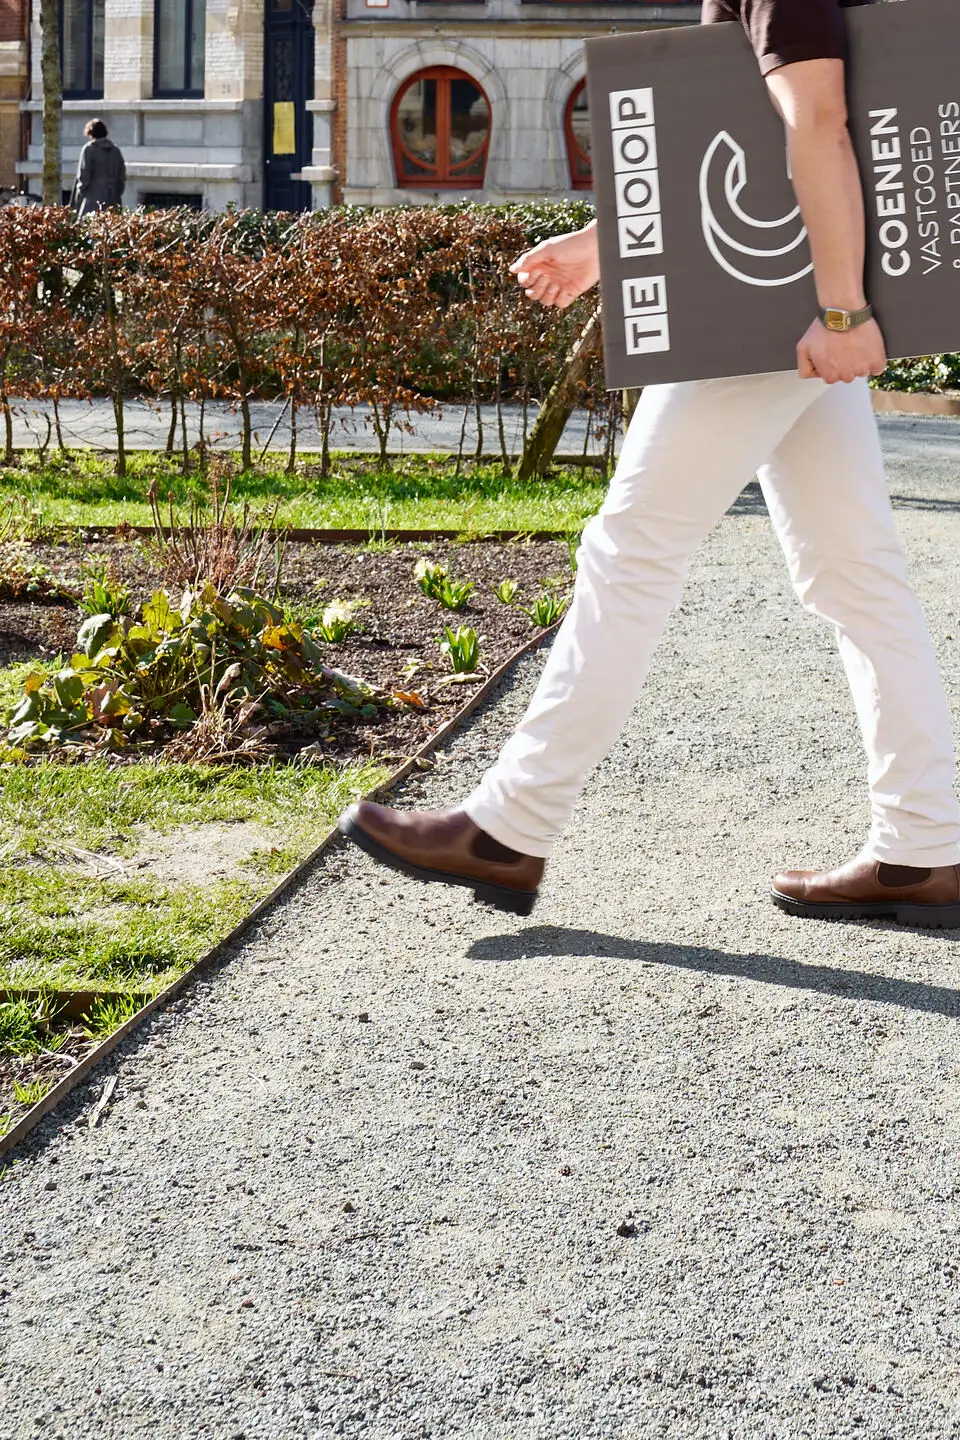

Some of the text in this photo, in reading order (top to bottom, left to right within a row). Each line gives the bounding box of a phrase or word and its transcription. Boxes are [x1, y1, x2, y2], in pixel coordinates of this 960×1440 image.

[616, 95, 664, 350] TE KOOP
[869, 107, 910, 277] COENEN
[909, 126, 939, 275] VASTGOED
